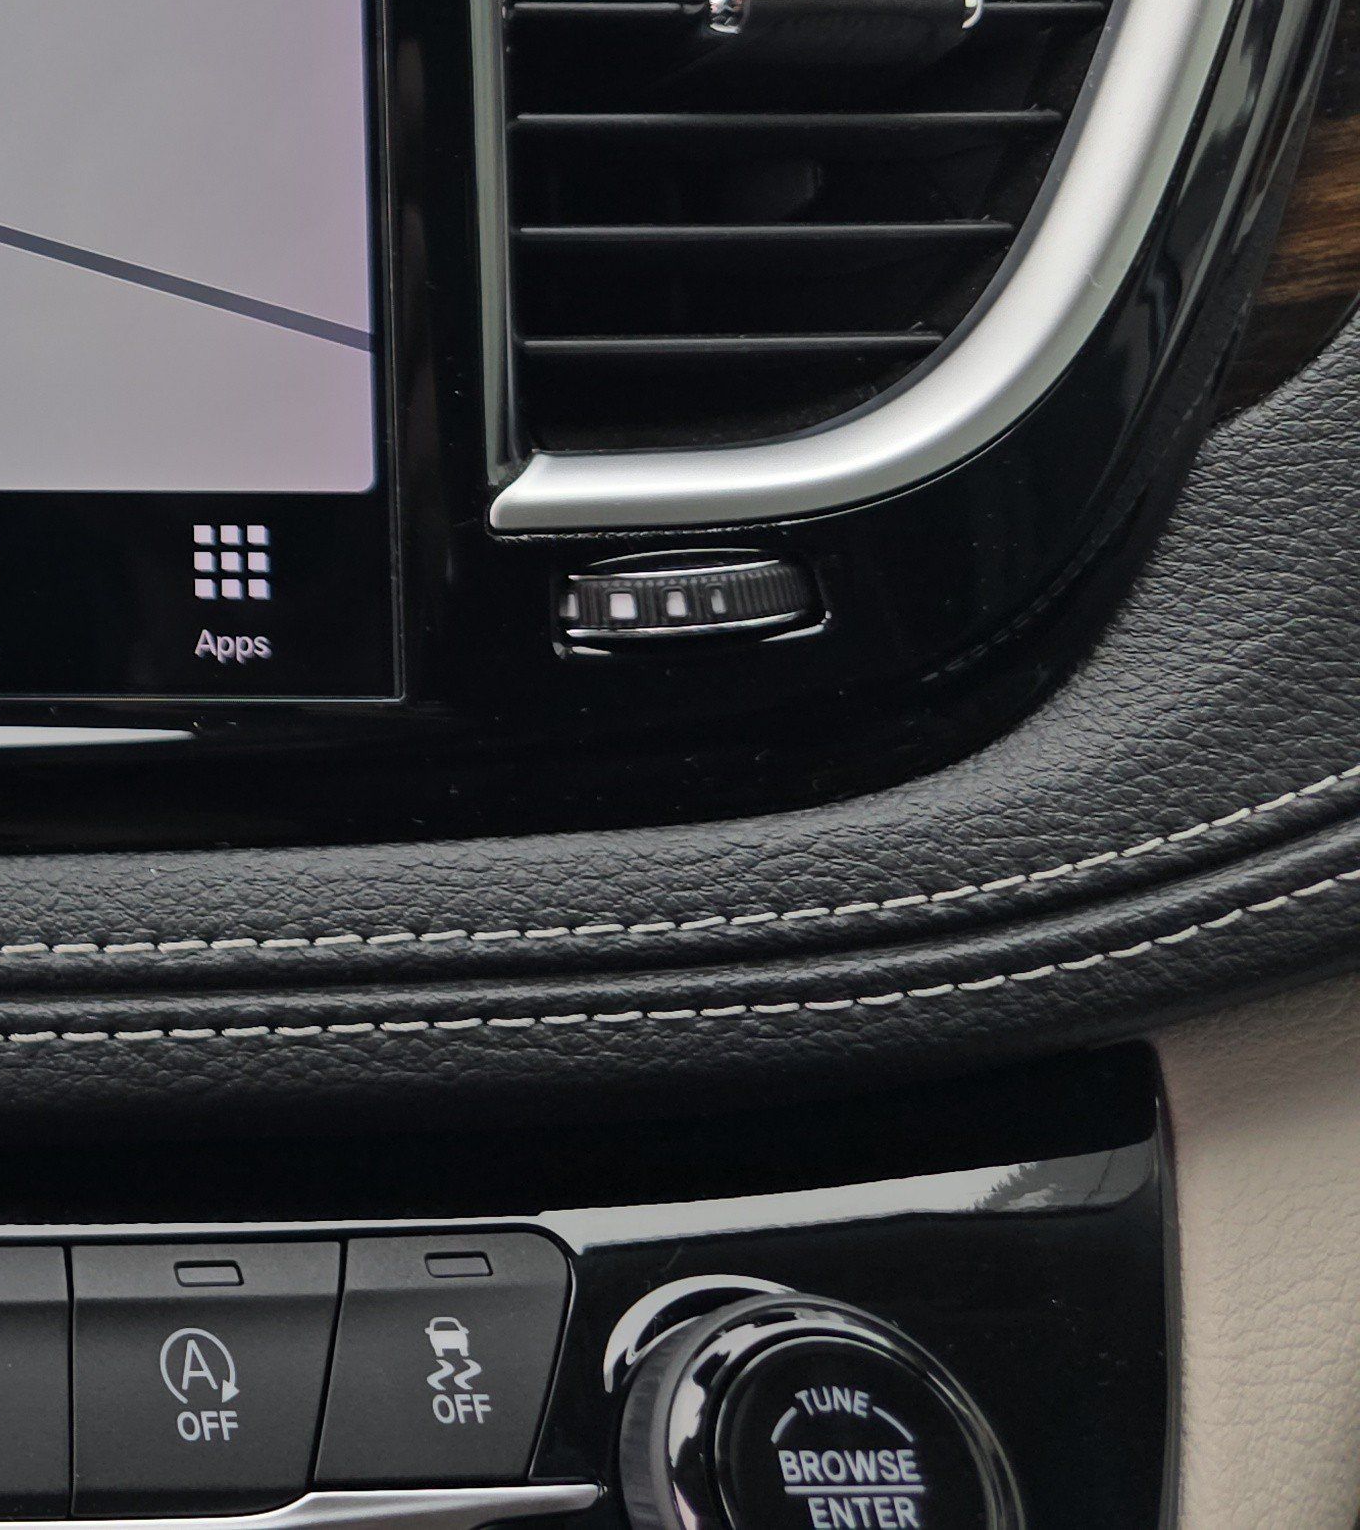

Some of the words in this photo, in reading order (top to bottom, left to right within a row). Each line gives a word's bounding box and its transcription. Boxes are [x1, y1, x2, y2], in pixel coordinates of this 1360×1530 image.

[195, 628, 273, 663] Apps
[432, 1393, 492, 1426] OFF
[794, 1385, 870, 1419] TUNE
[177, 1410, 239, 1442] OFF
[778, 1449, 923, 1483] BROWSE
[807, 1496, 922, 1529] ENTER
